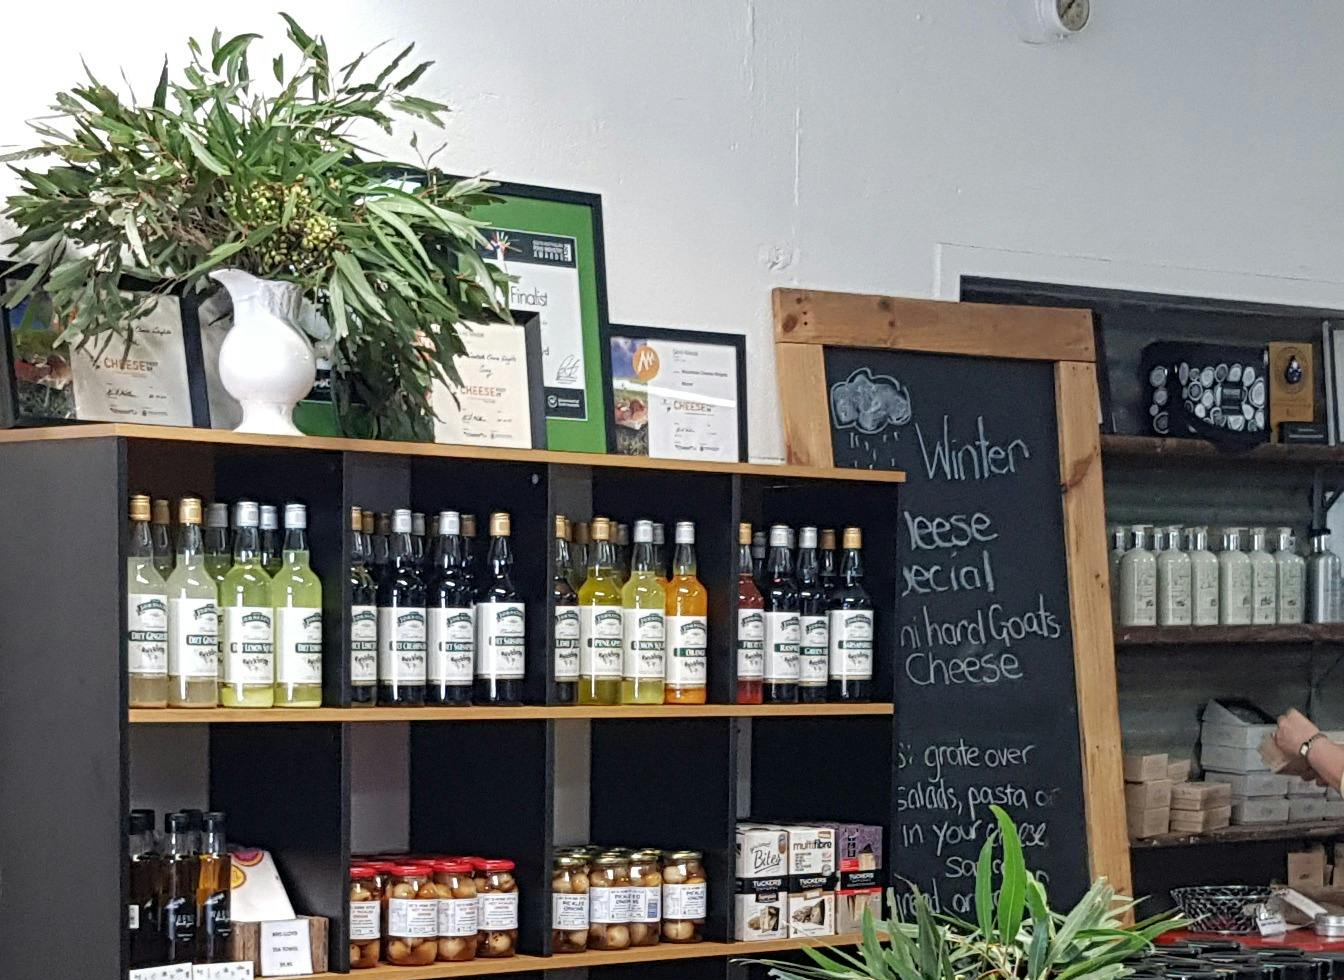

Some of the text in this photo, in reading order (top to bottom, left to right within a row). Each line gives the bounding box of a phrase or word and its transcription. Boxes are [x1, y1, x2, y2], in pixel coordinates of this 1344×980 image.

[511, 287, 548, 307] Finalist
[461, 386, 496, 397] CHEESE
[674, 400, 706, 412] CHEESE
[916, 415, 1030, 480] Winter
[924, 593, 1062, 647] hard Goats
[906, 652, 1023, 686] Cheese
[924, 738, 1035, 782] grate over
[968, 783, 1028, 820] pasta
[793, 838, 832, 851] multifibre
[933, 820, 982, 857] your
[754, 850, 782, 869] Bites
[752, 879, 782, 887] TUCKERS
[799, 878, 827, 886] TUCKERS
